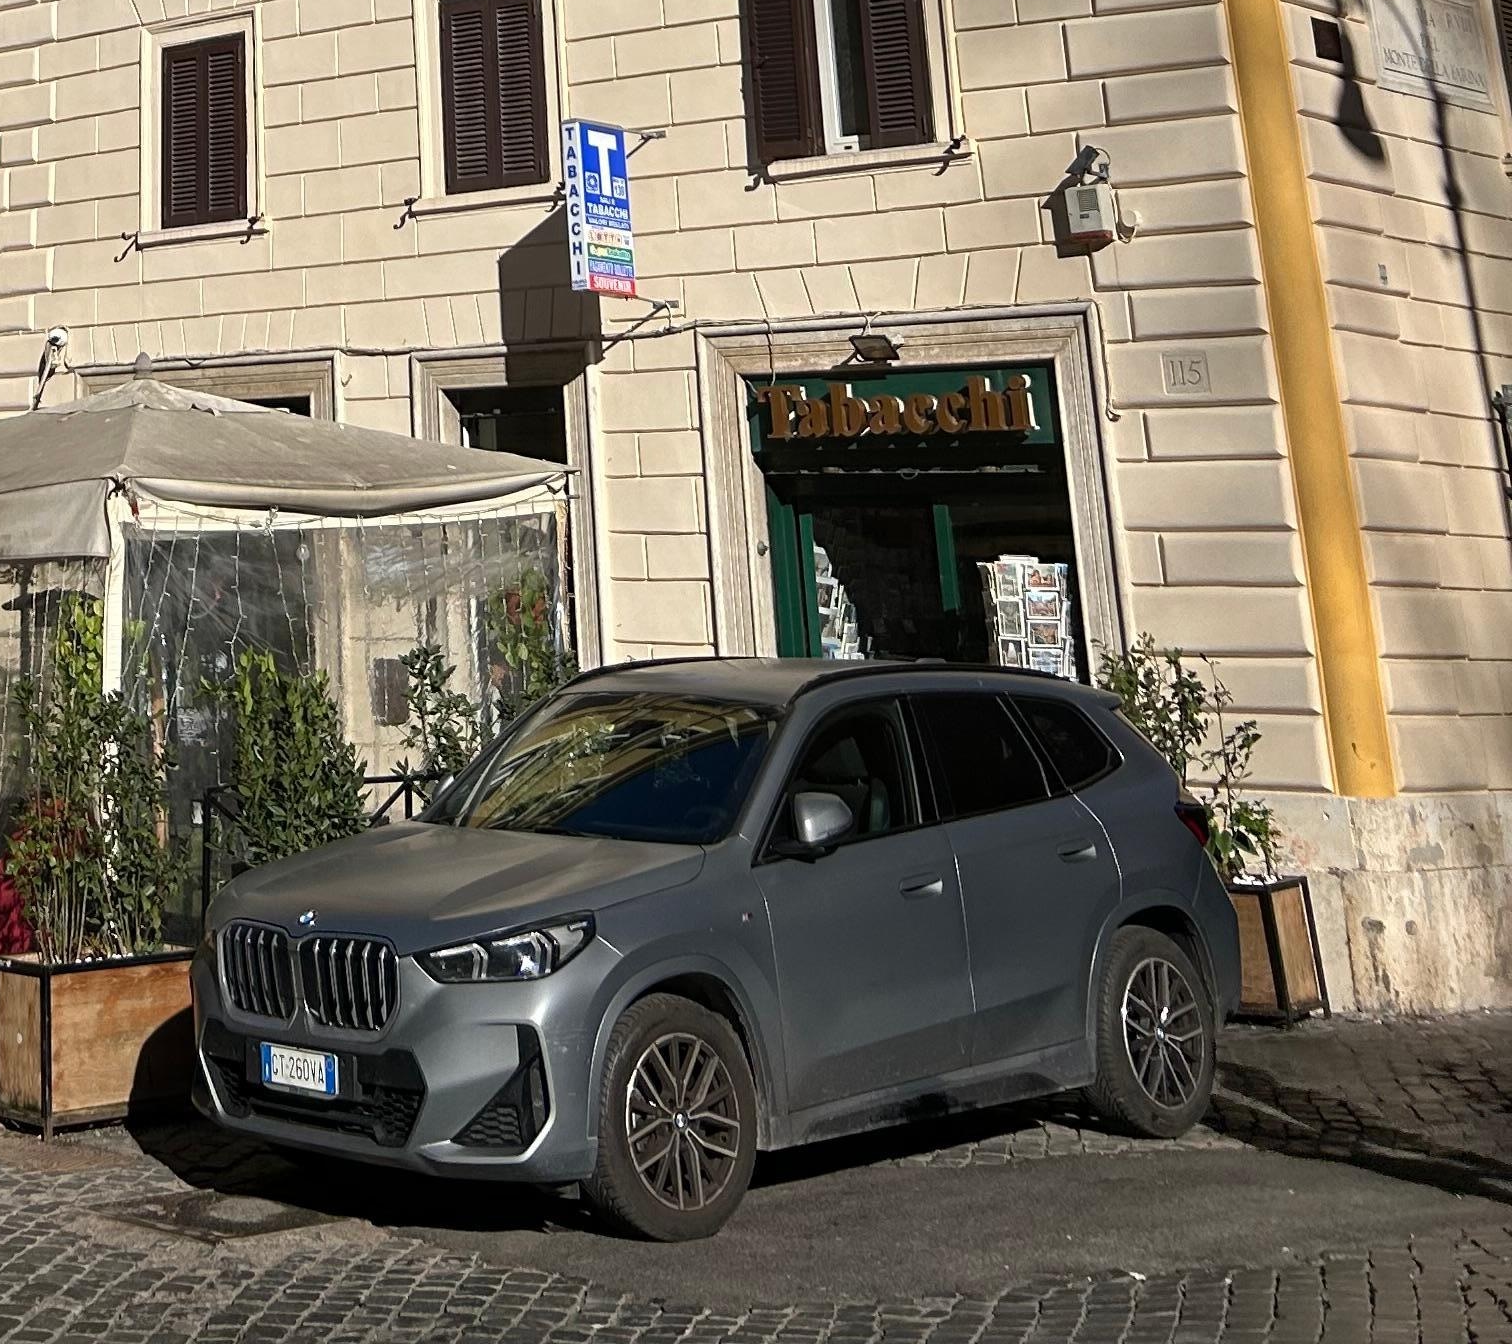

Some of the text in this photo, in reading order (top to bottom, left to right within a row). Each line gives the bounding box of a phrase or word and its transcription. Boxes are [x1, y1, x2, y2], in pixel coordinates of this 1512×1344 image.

[1383, 46, 1417, 69] MONTE
[587, 129, 618, 197] T
[564, 126, 583, 275] TABACCHI
[587, 202, 629, 220] TABACCHI
[593, 275, 632, 293] SOUVENIR
[1169, 359, 1202, 386] 115
[757, 373, 1036, 439] Tabacchi
[288, 1056, 325, 1085] 260VA
